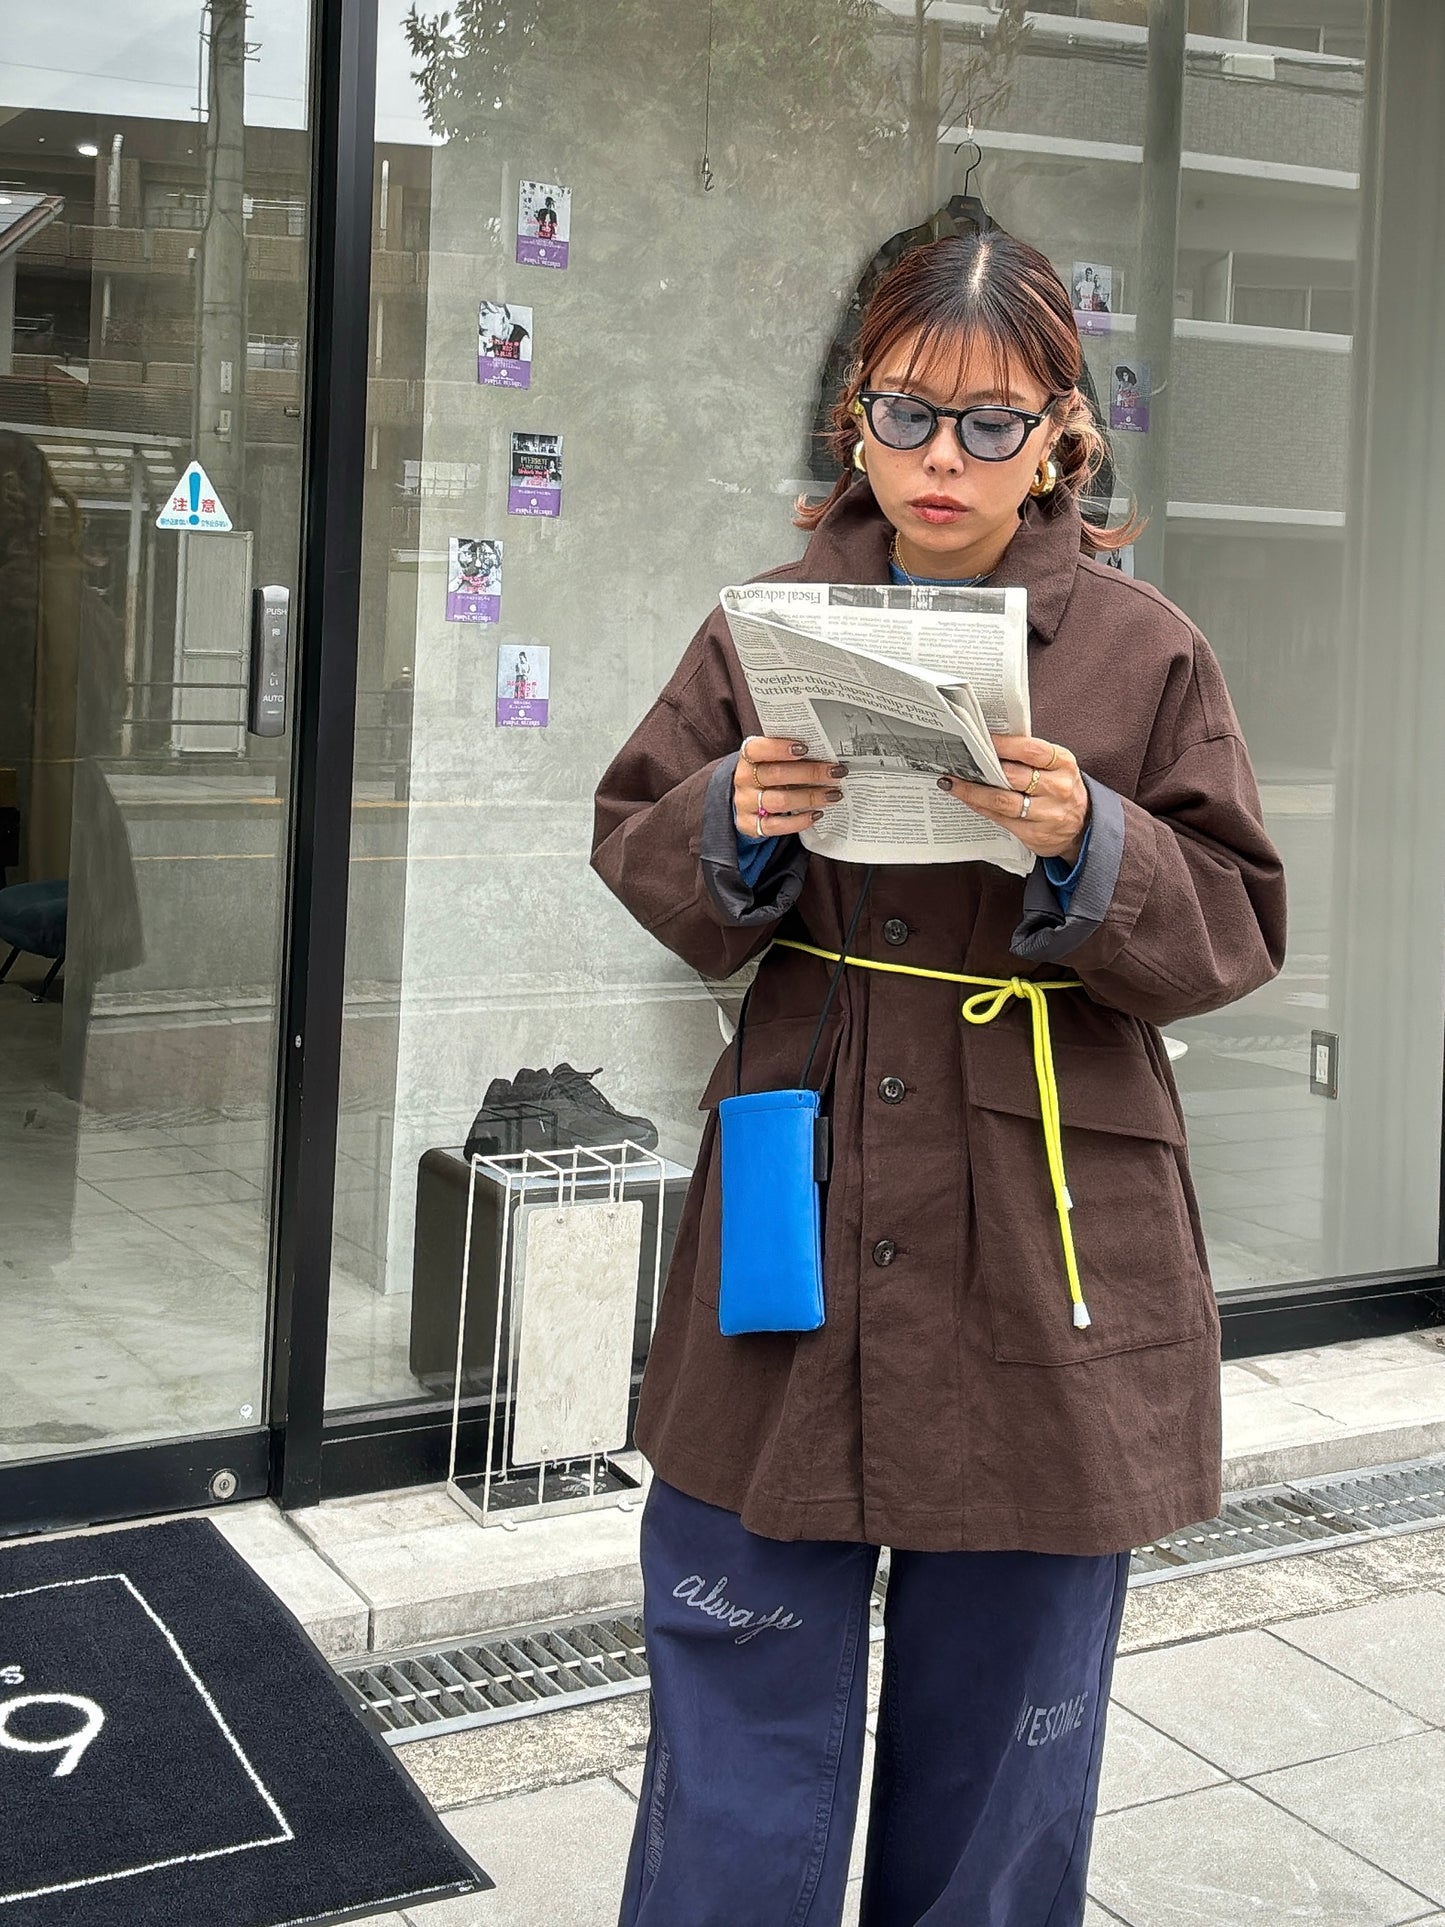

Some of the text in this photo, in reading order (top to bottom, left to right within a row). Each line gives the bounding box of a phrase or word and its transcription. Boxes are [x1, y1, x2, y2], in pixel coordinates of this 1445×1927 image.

[788, 591, 821, 604] Fiscal
[265, 608, 288, 616] PUSH
[263, 694, 285, 703] AUTO
[755, 674, 804, 686] weighs
[805, 675, 837, 689] third
[838, 682, 875, 699] Japan
[905, 704, 940, 720] plant
[754, 685, 835, 697] cutting-edge
[915, 714, 944, 728] tech
